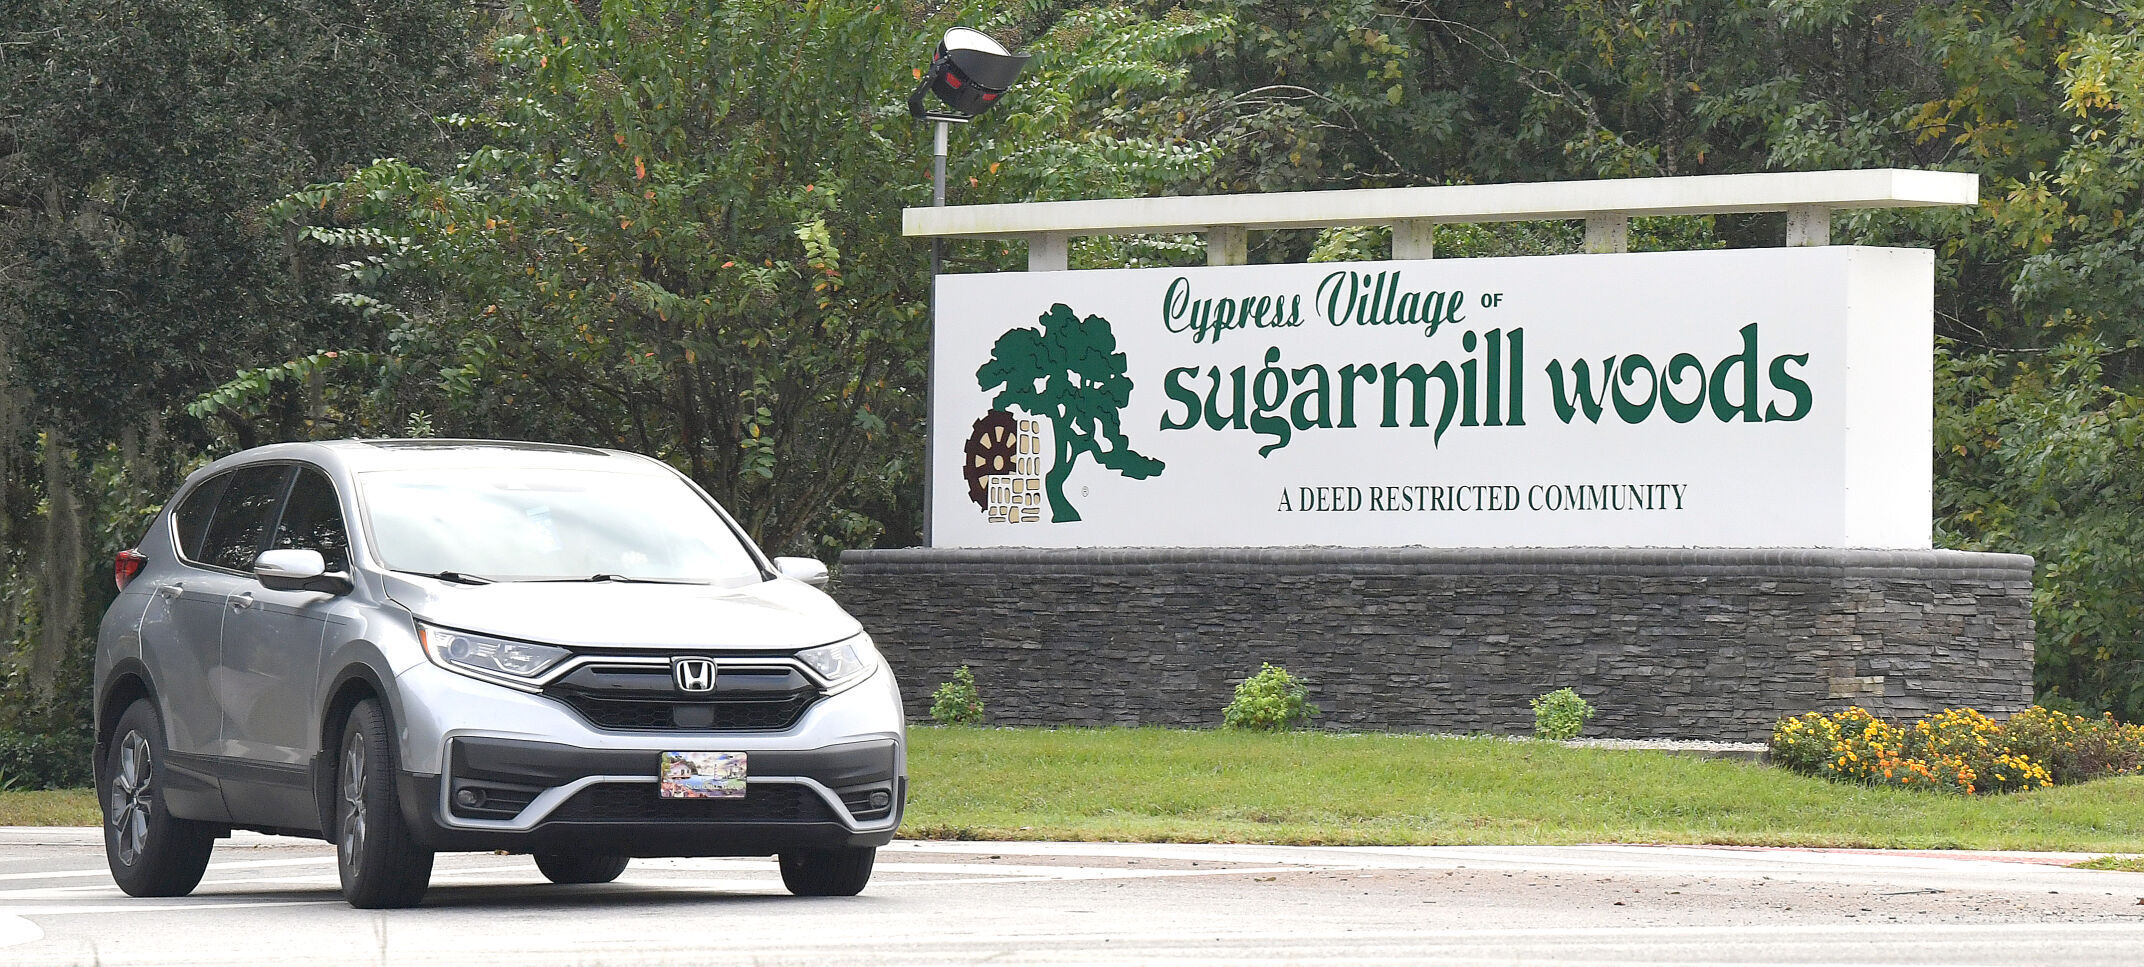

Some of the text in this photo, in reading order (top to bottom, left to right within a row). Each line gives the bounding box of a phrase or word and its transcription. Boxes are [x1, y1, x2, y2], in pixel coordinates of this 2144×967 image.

[1162, 270, 1504, 345] Cypress Village OF
[1159, 322, 1813, 459] sugarmill woods
[1277, 484, 1688, 512] A DEED RESTRICTED COMMUNITY
